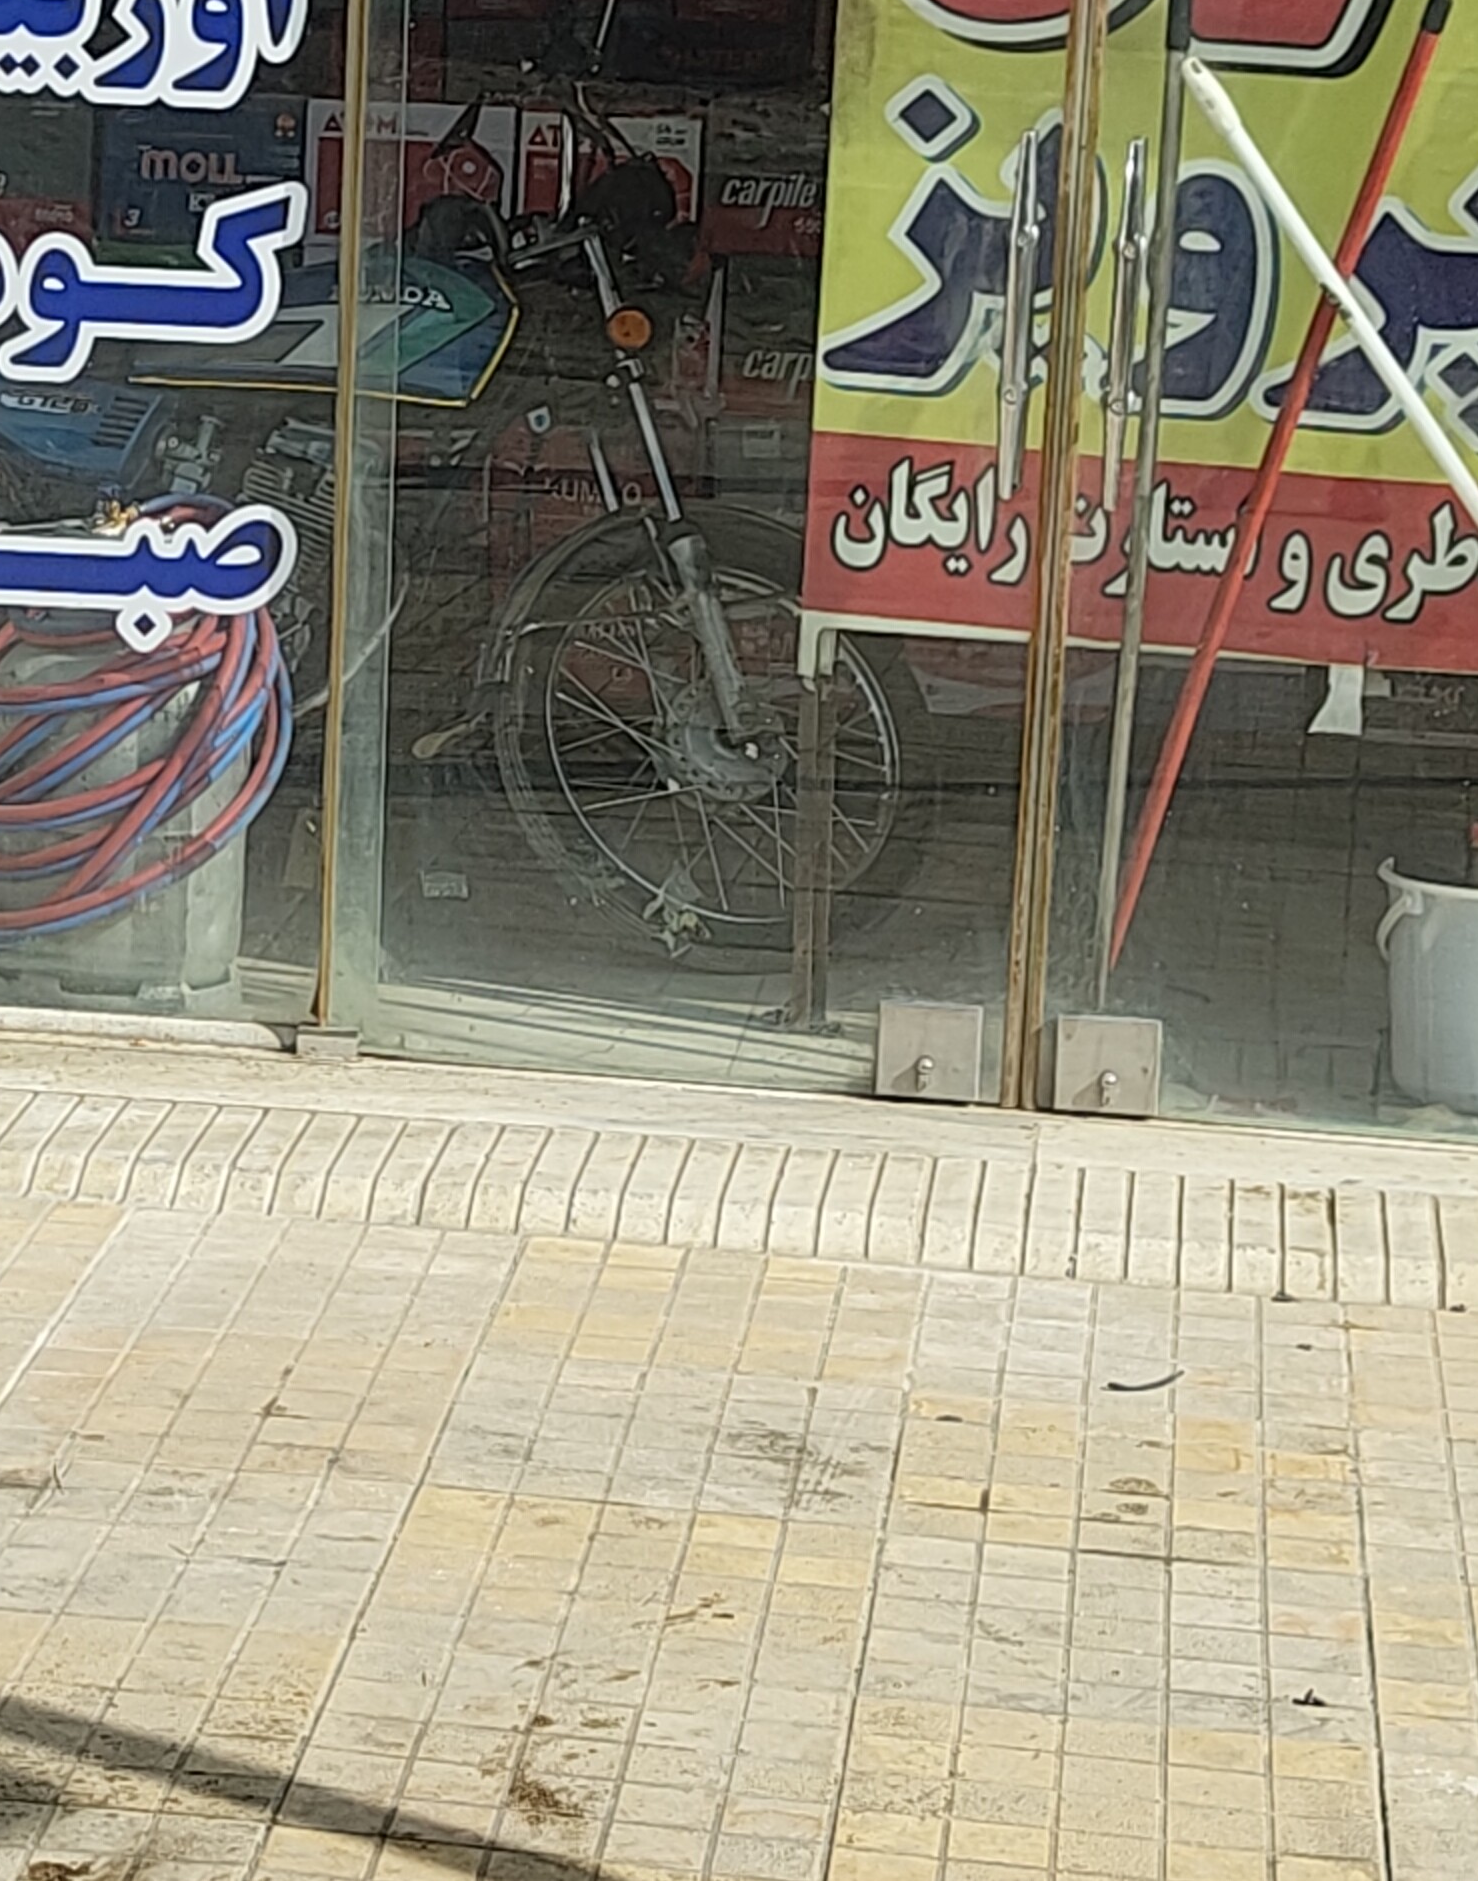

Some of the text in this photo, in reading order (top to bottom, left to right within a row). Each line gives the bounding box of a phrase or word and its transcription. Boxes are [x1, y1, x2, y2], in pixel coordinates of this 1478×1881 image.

[721, 174, 819, 230] carpile
[831, 455, 1032, 586] رایگان
[1266, 530, 1314, 612] و
